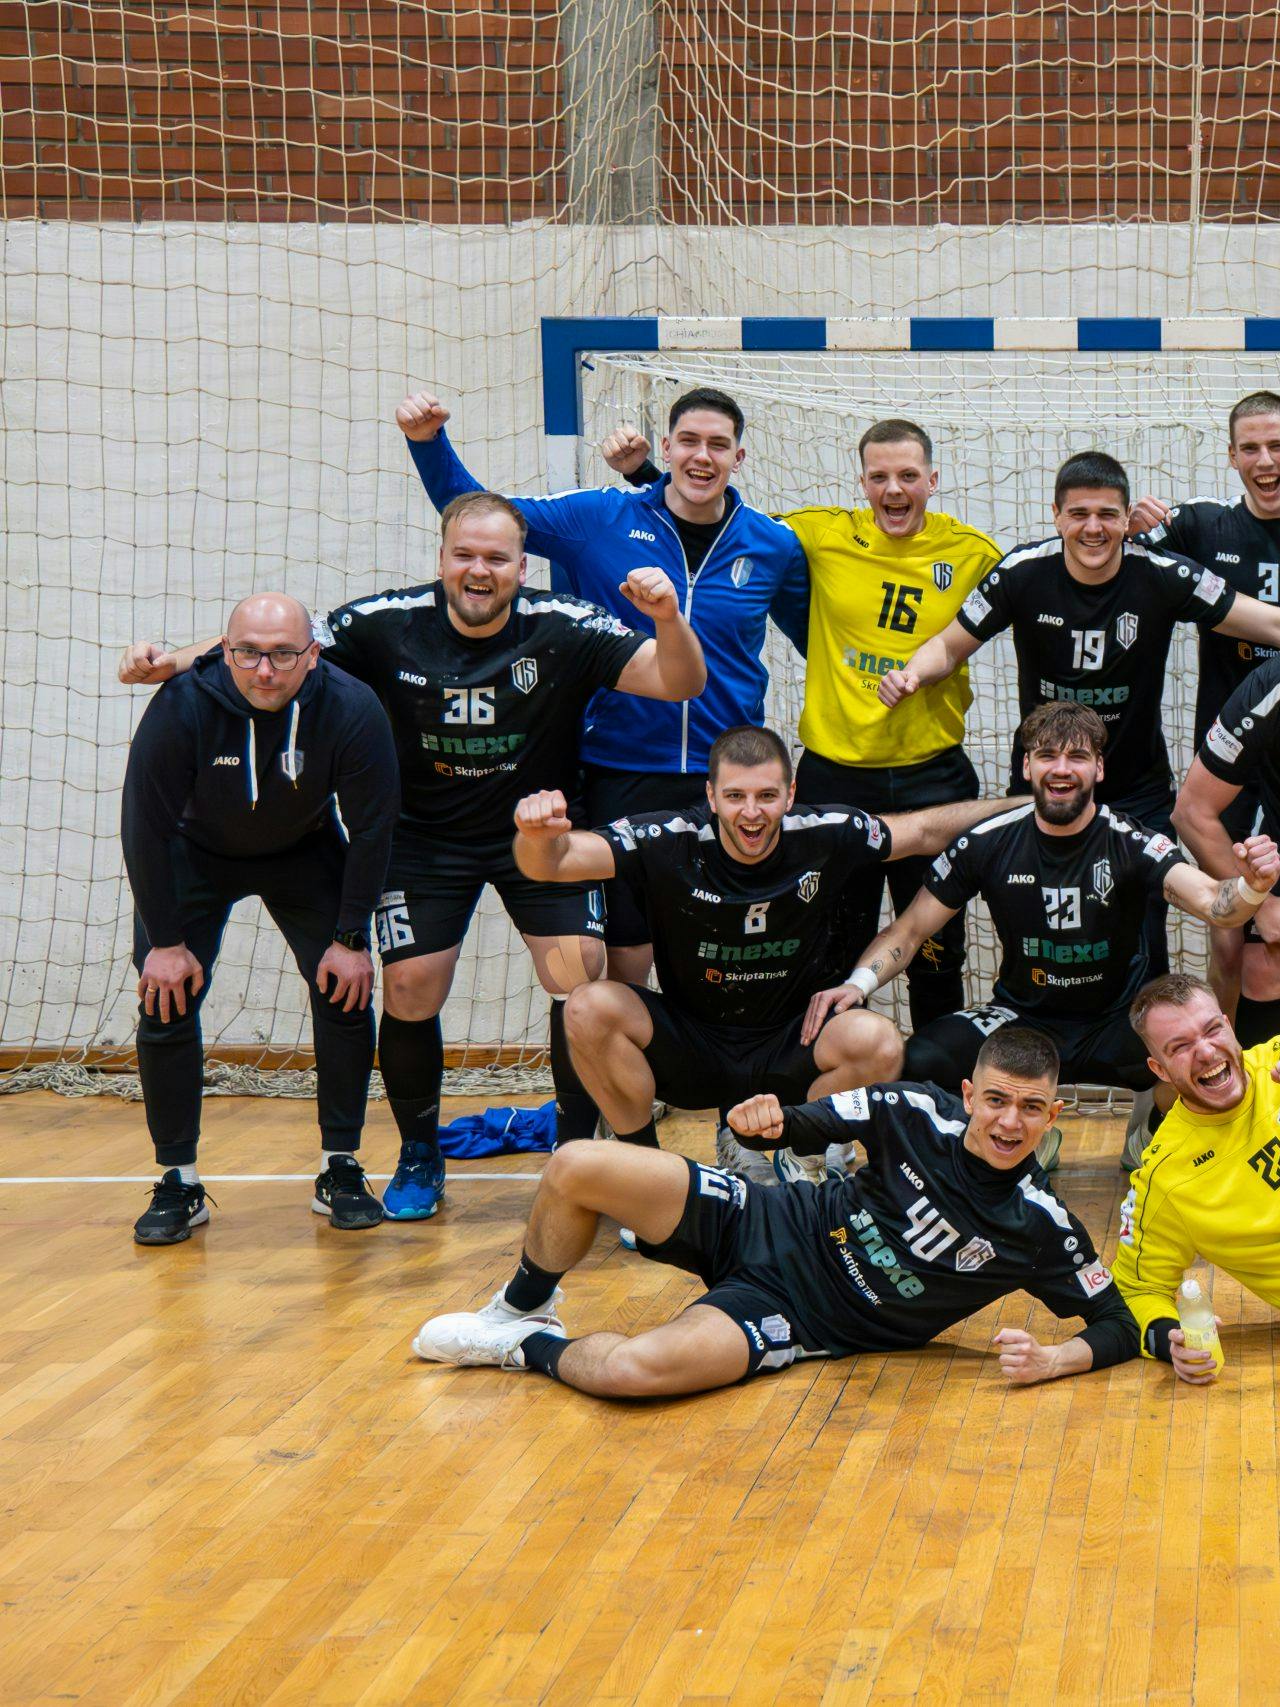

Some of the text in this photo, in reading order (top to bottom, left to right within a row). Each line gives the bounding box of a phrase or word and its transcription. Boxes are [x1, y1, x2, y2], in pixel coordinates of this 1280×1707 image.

[628, 528, 656, 543] JAKO
[853, 534, 870, 549] JAKO
[1215, 551, 1241, 564] JAKO
[877, 581, 923, 634] 16
[1037, 613, 1064, 626] JAKO
[1071, 630, 1106, 670] 19
[858, 651, 910, 676] nex
[398, 671, 427, 686] JAKO
[443, 686, 495, 724] 36
[1057, 685, 1130, 705] nexe
[213, 756, 240, 766] JAKO
[1007, 874, 1036, 885] JAKO
[691, 887, 722, 904] JAKO
[744, 902, 771, 934] 8
[1041, 887, 1082, 930] 23
[719, 938, 801, 961] nexe
[1041, 938, 1110, 964] nexe
[1192, 1149, 1216, 1168] JAKO
[899, 1161, 925, 1191] JAKO
[901, 1195, 961, 1263] 40
[857, 1223, 925, 1300] nexe
[744, 1319, 765, 1351] JAKO
